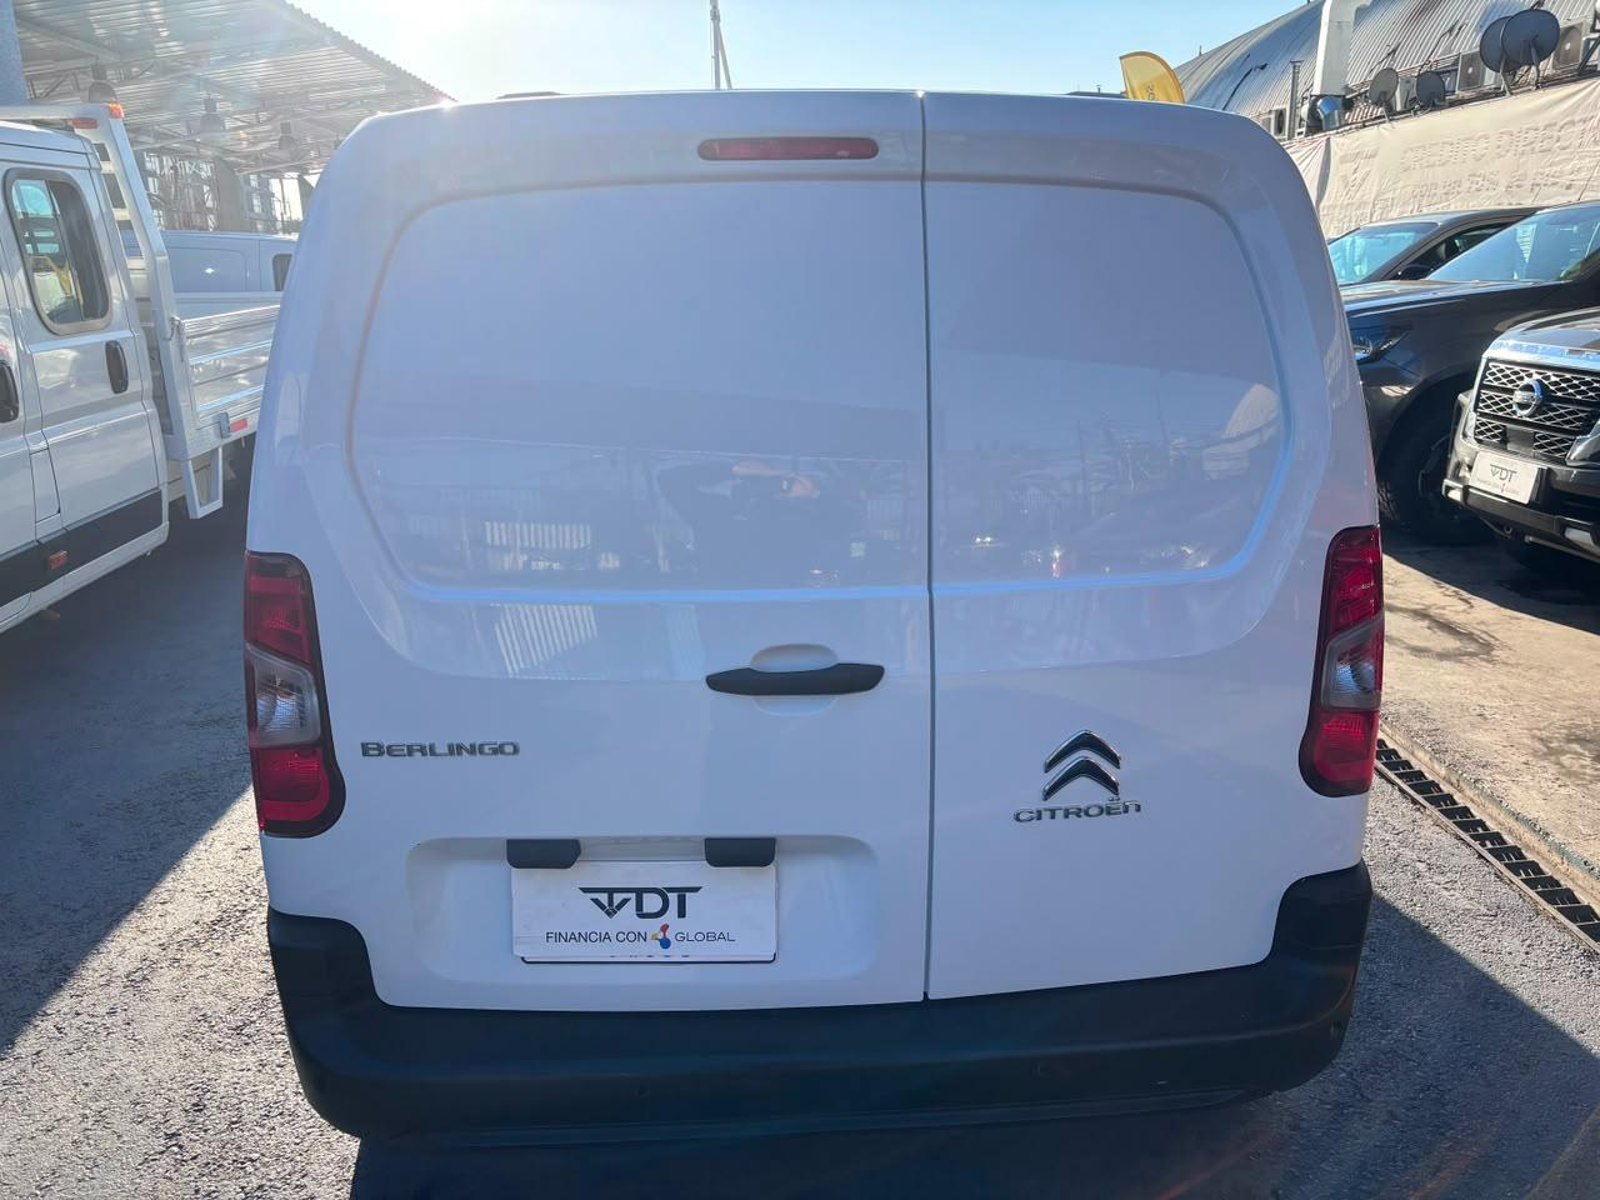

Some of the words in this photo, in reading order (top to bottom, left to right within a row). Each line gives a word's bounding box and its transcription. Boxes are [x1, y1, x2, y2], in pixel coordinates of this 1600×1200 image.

[360, 742, 520, 757] BERLINGO
[545, 931, 612, 944] FINANCIA
[616, 931, 648, 944] CON
[674, 931, 736, 944] GLOBAL
